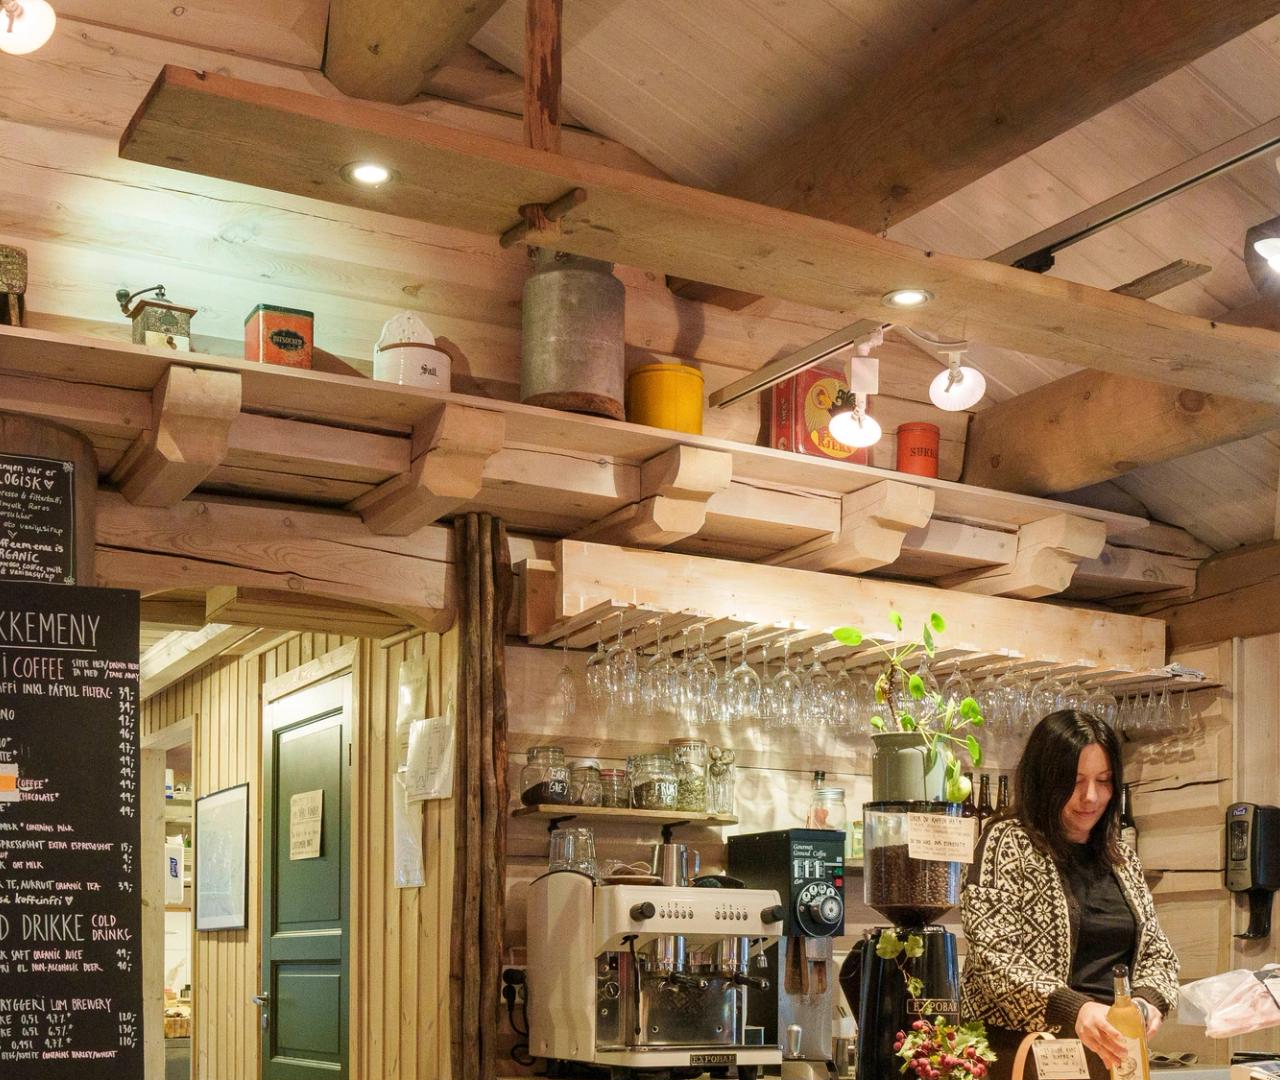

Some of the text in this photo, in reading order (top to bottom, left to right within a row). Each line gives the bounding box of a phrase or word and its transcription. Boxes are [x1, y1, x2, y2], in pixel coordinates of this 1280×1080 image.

[27, 466, 41, 476] vår
[46, 469, 57, 477] er
[55, 543, 64, 552] is
[13, 656, 65, 681] COFFEE
[22, 914, 85, 942] DRIKKE
[92, 915, 117, 927] COLD
[92, 928, 132, 941] DRINKS
[11, 949, 31, 960] SAFT
[64, 949, 83, 960] JUICE
[51, 999, 67, 1011] LOM
[71, 998, 112, 1013] BREWERY
